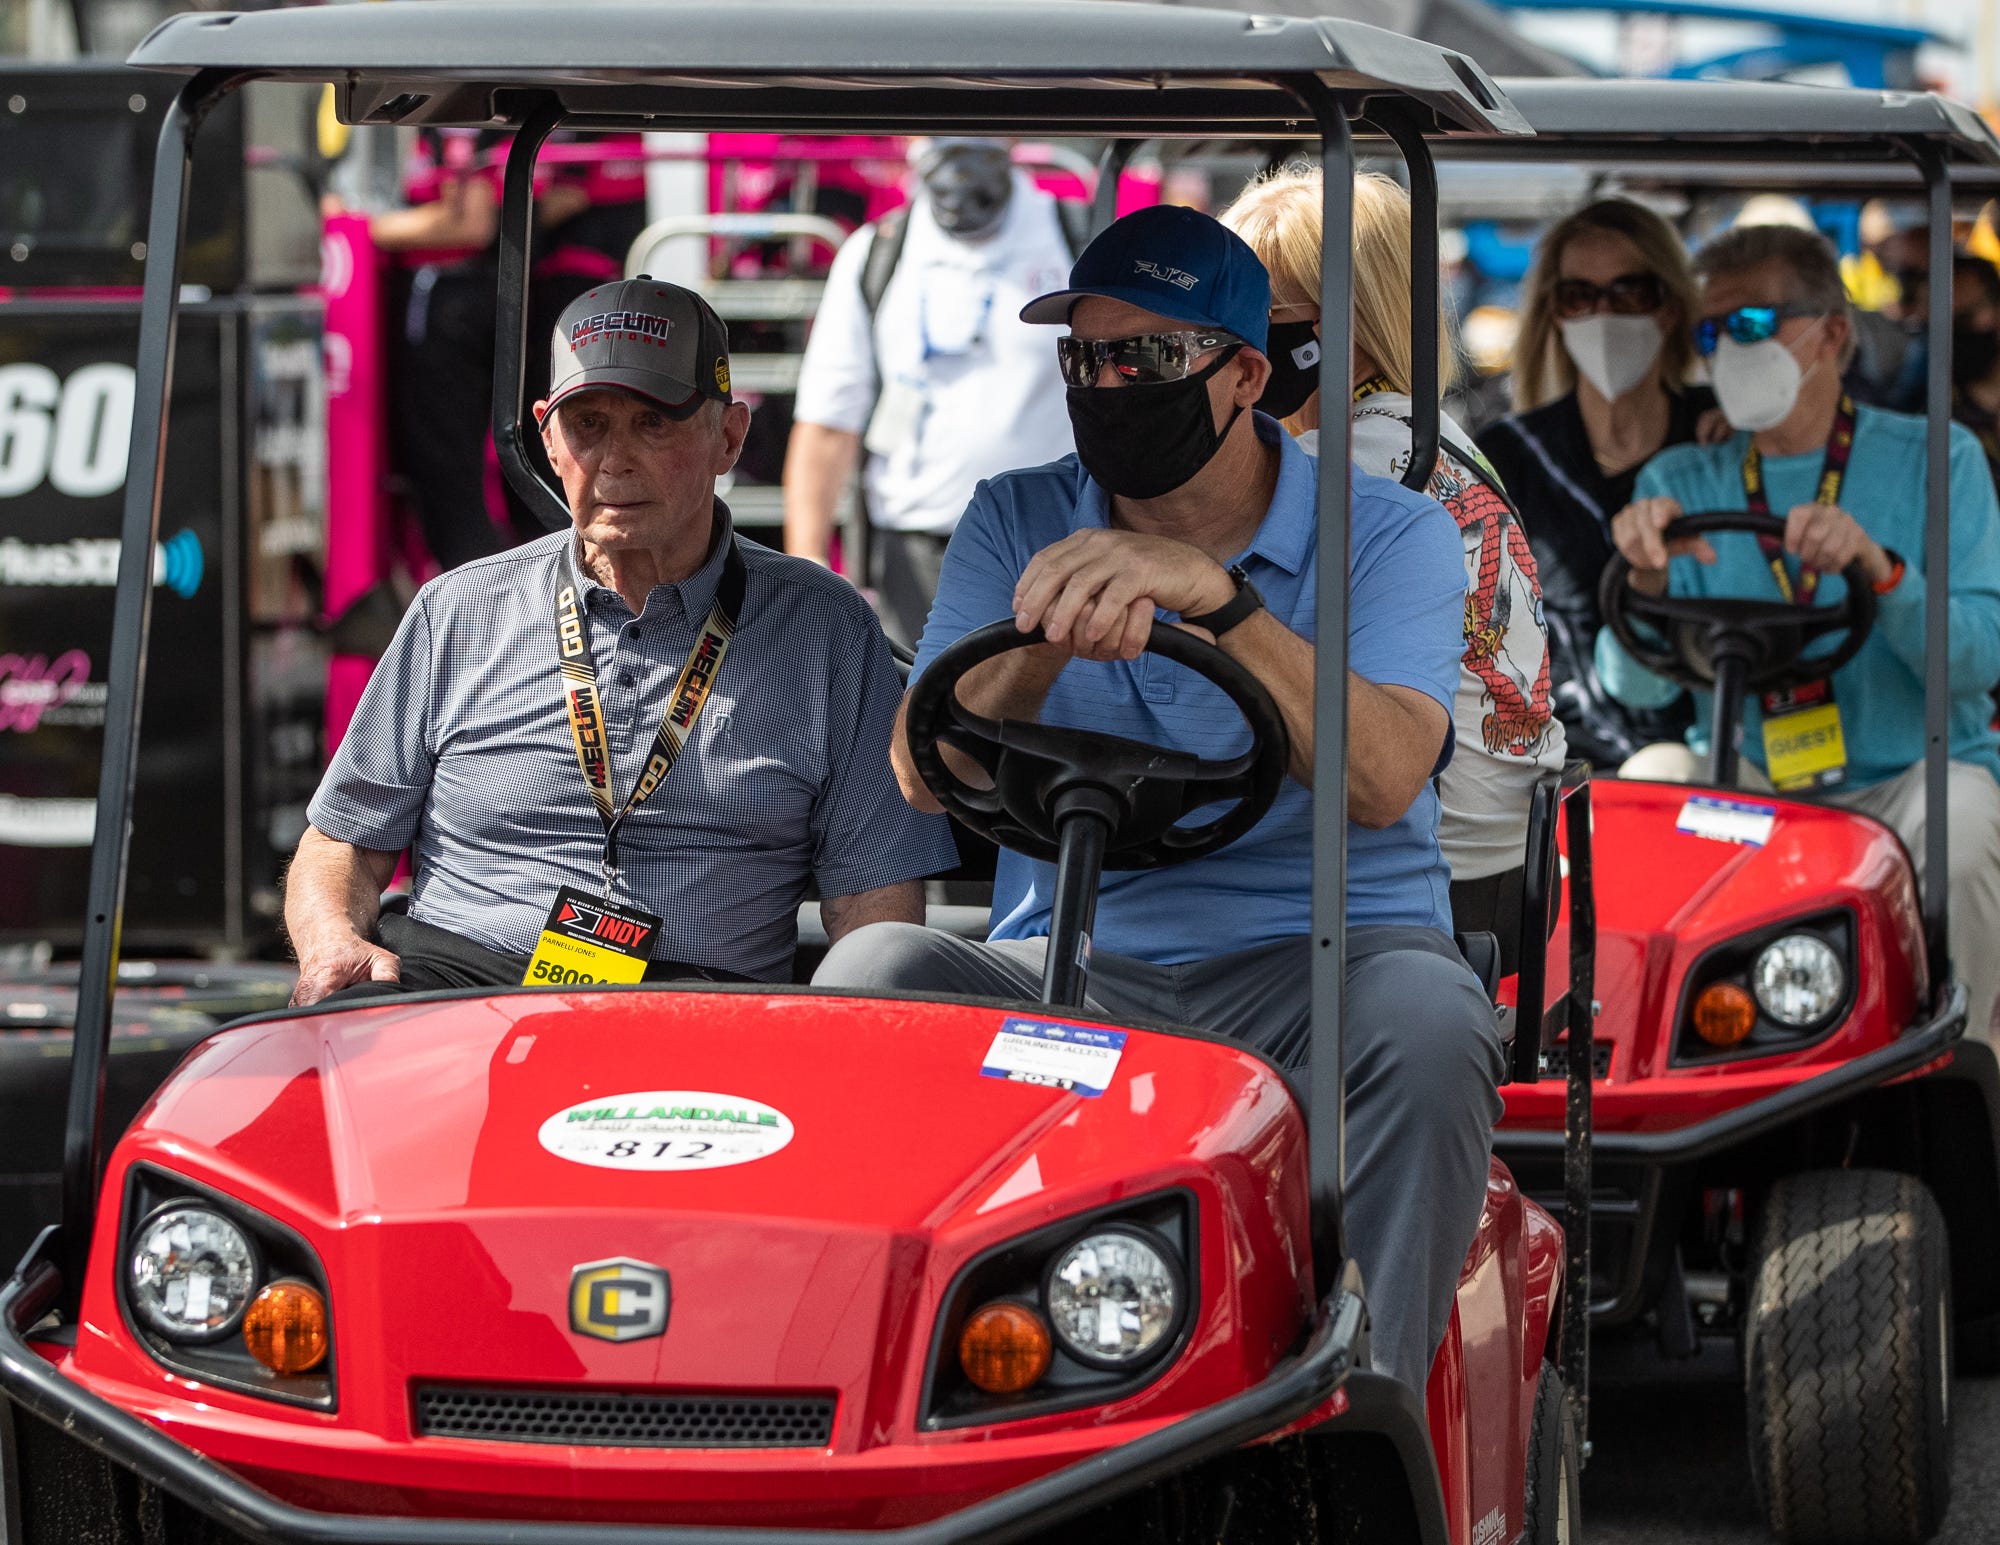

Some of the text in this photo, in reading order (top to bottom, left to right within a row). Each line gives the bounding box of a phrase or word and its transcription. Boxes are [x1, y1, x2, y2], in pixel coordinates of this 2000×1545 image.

[1134, 260, 1199, 291] PJ'S
[570, 331, 667, 352] AUCTIONS
[571, 311, 669, 342] MECUM
[0, 362, 137, 498] 60
[559, 586, 584, 658] GOLD
[669, 632, 724, 729] MECUM
[571, 687, 606, 789] MECUM
[595, 915, 649, 948] INDY
[542, 936, 574, 951] PARNELLI
[575, 946, 597, 959] JONES
[1063, 1045, 1110, 1059] ACCESS
[1007, 1070, 1074, 1090] 2021
[567, 1106, 779, 1127] WILLANDALE
[605, 1140, 713, 1159] 812
